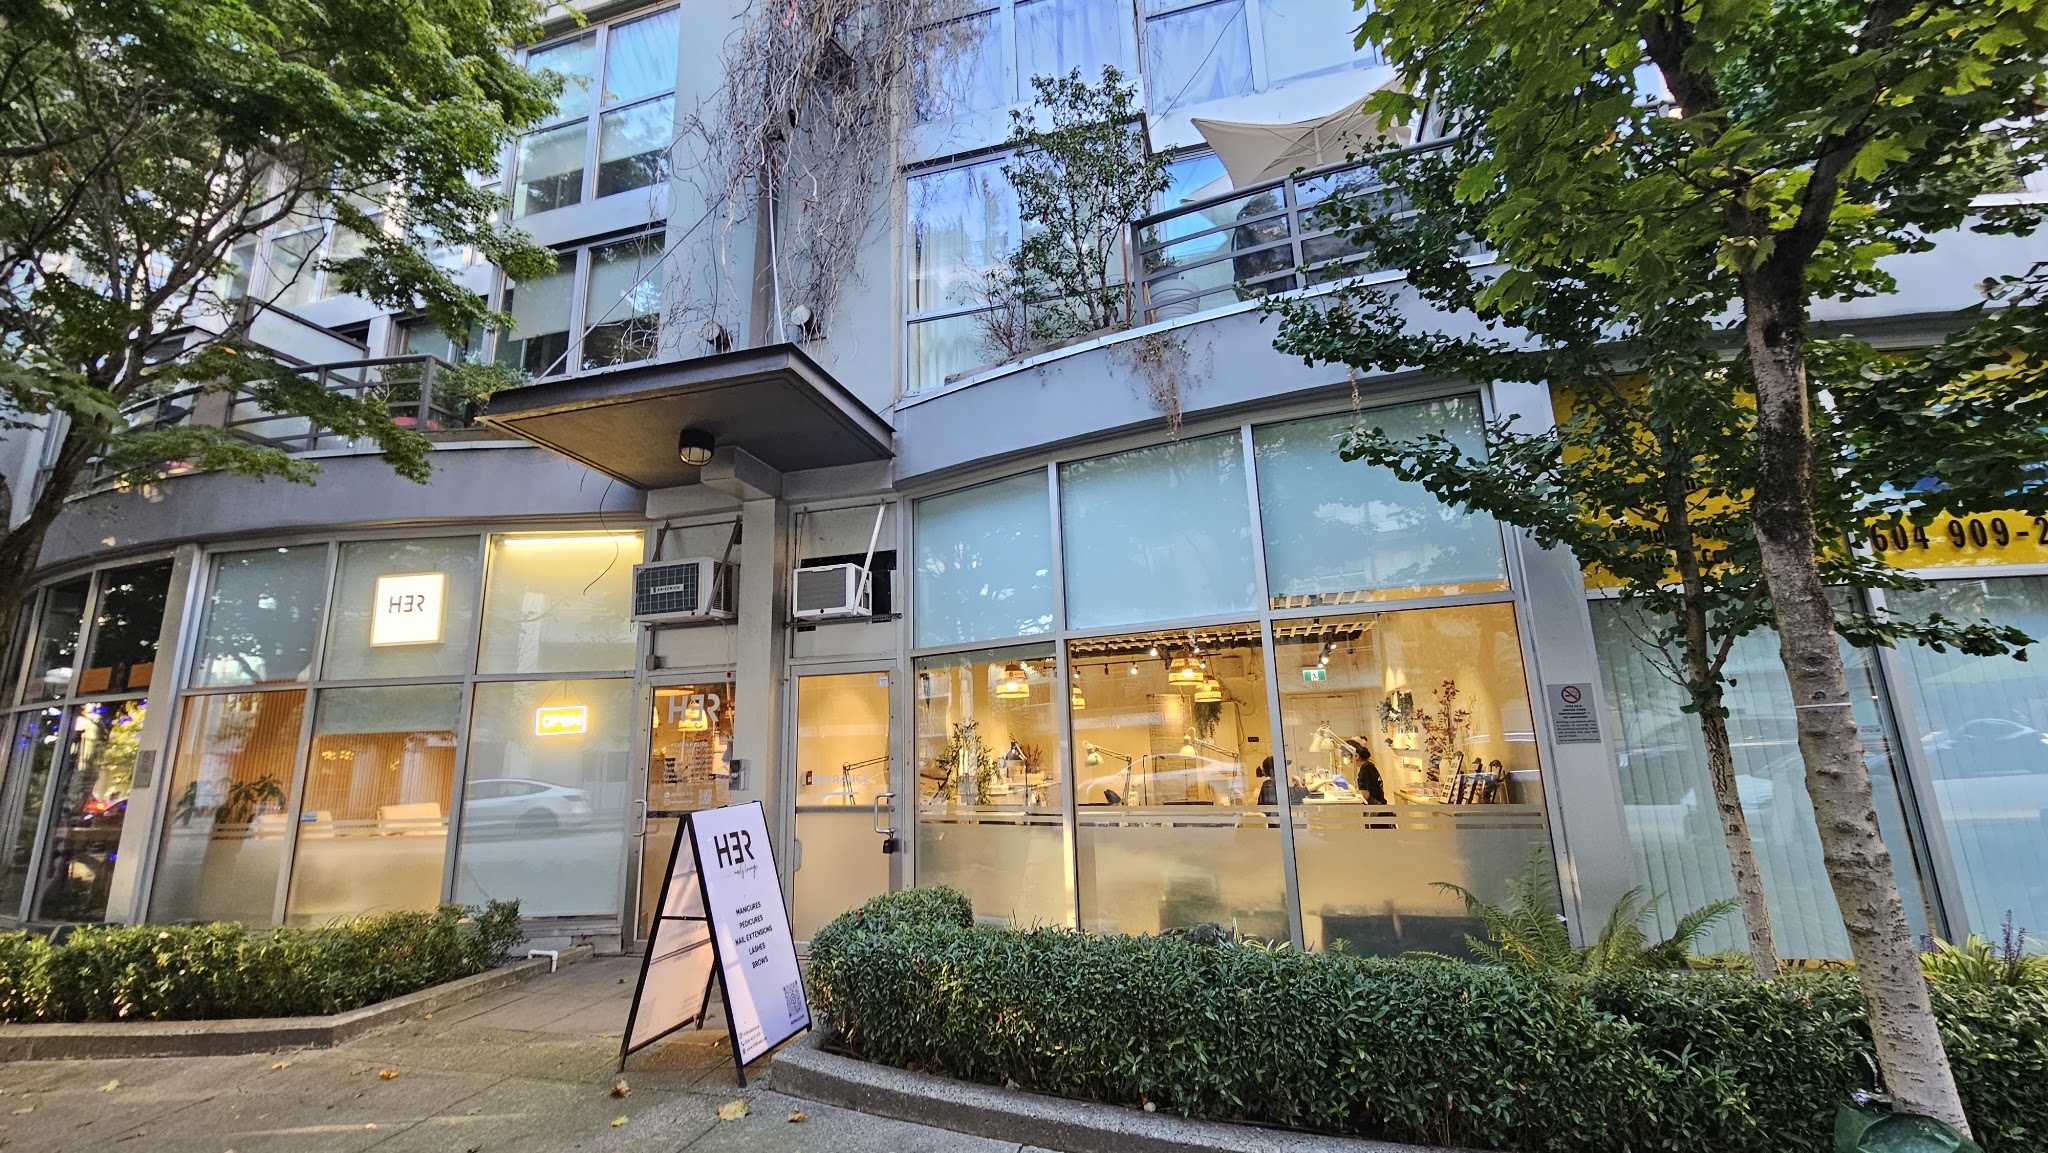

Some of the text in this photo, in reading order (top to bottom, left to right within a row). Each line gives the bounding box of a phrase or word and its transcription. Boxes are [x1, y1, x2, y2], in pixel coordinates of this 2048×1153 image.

[1870, 522, 1930, 552] 604
[735, 901, 761, 916] MANICURES
[739, 914, 764, 929] PEDICURES
[734, 924, 773, 946] NAIL EXTENSIONS
[748, 942, 766, 955] LASHES
[751, 955, 769, 969] BROWS
